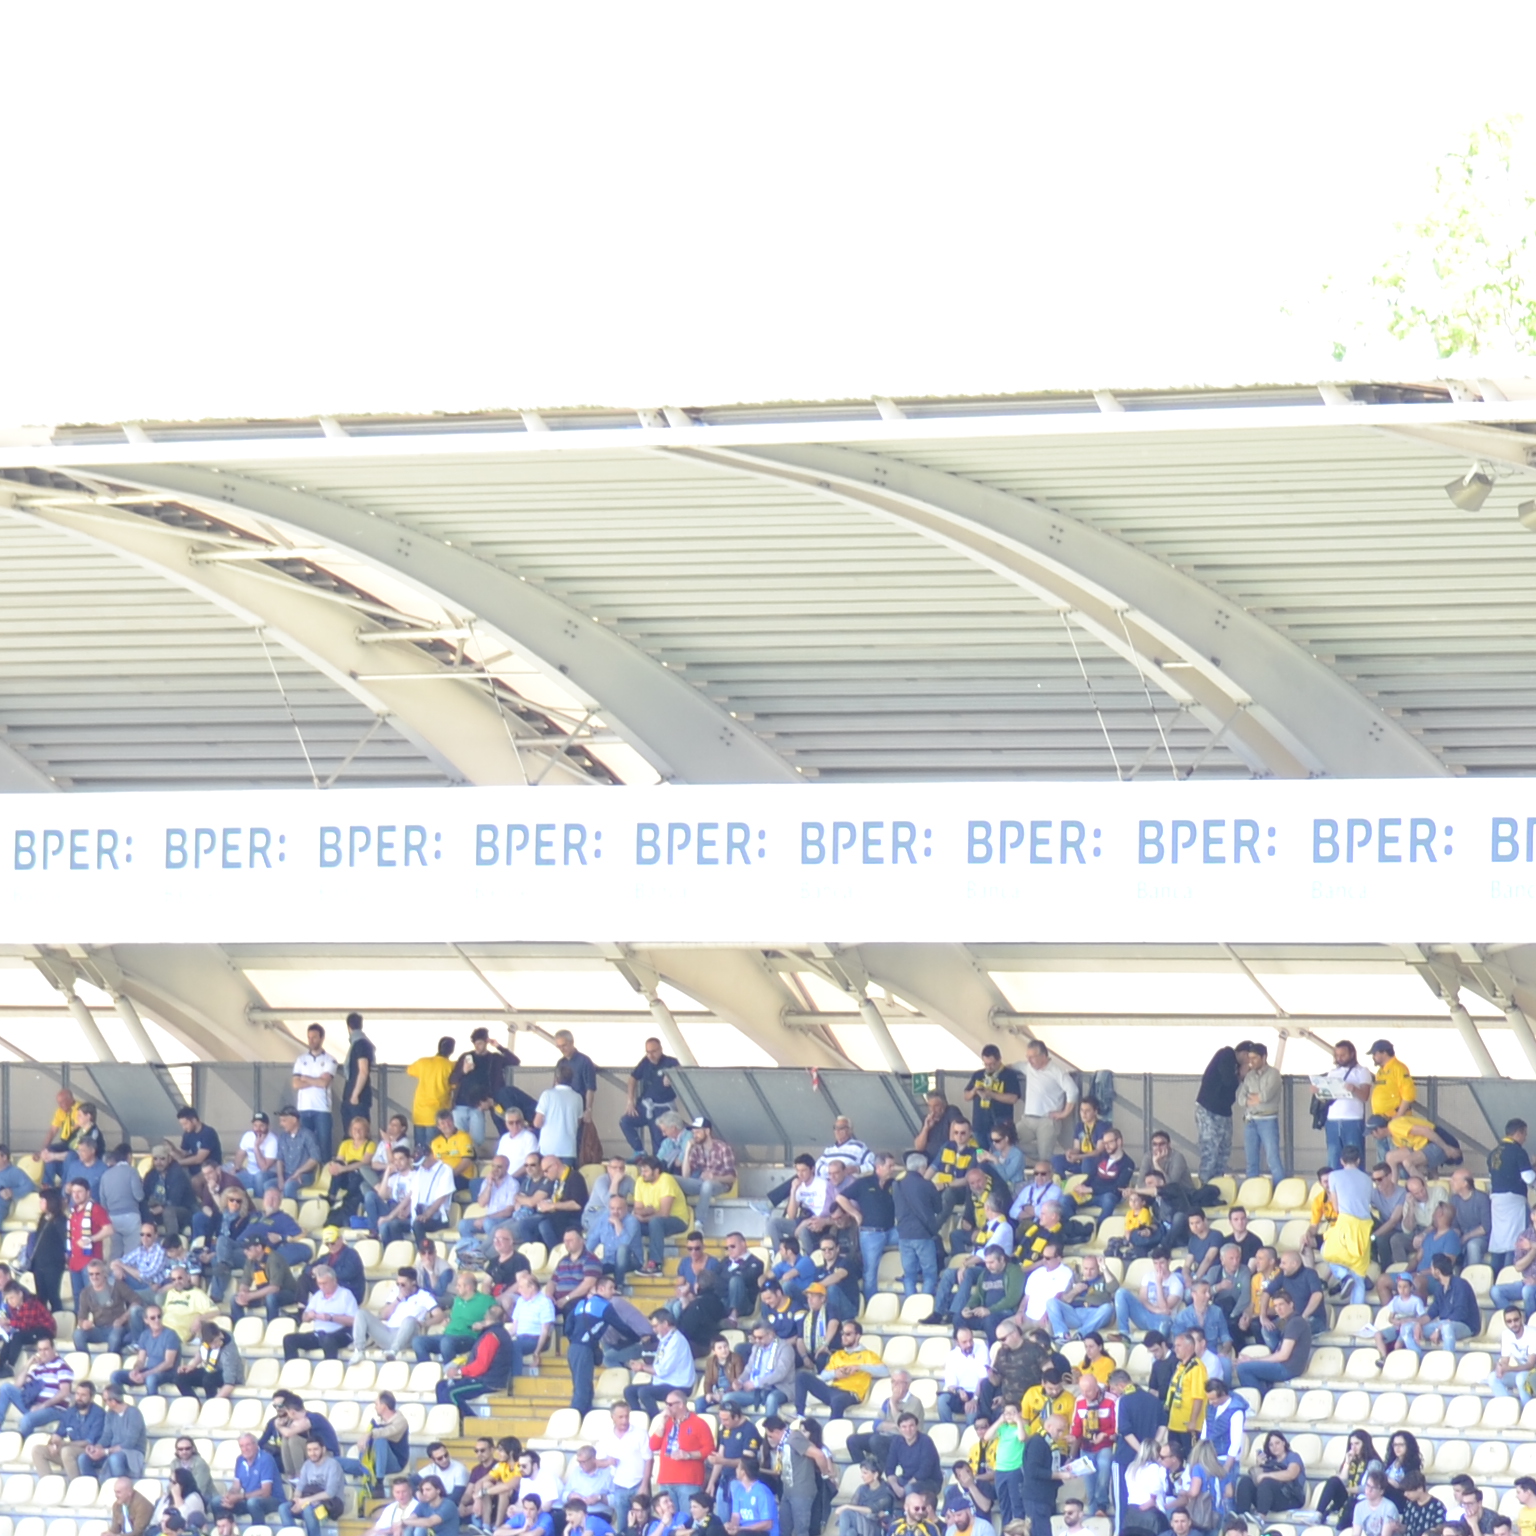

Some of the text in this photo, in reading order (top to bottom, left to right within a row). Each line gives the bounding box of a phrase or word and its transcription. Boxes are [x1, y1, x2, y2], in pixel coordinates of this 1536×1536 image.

[14, 829, 132, 870] BPER:
[166, 828, 285, 869] BPER:
[320, 825, 441, 868] BPER:
[476, 824, 601, 866] BPER:
[636, 822, 765, 865] BPER:
[801, 821, 931, 864] BPER:
[968, 820, 1101, 864] BPER:
[1139, 819, 1276, 864] BPER:
[1313, 818, 1453, 863] BPER:
